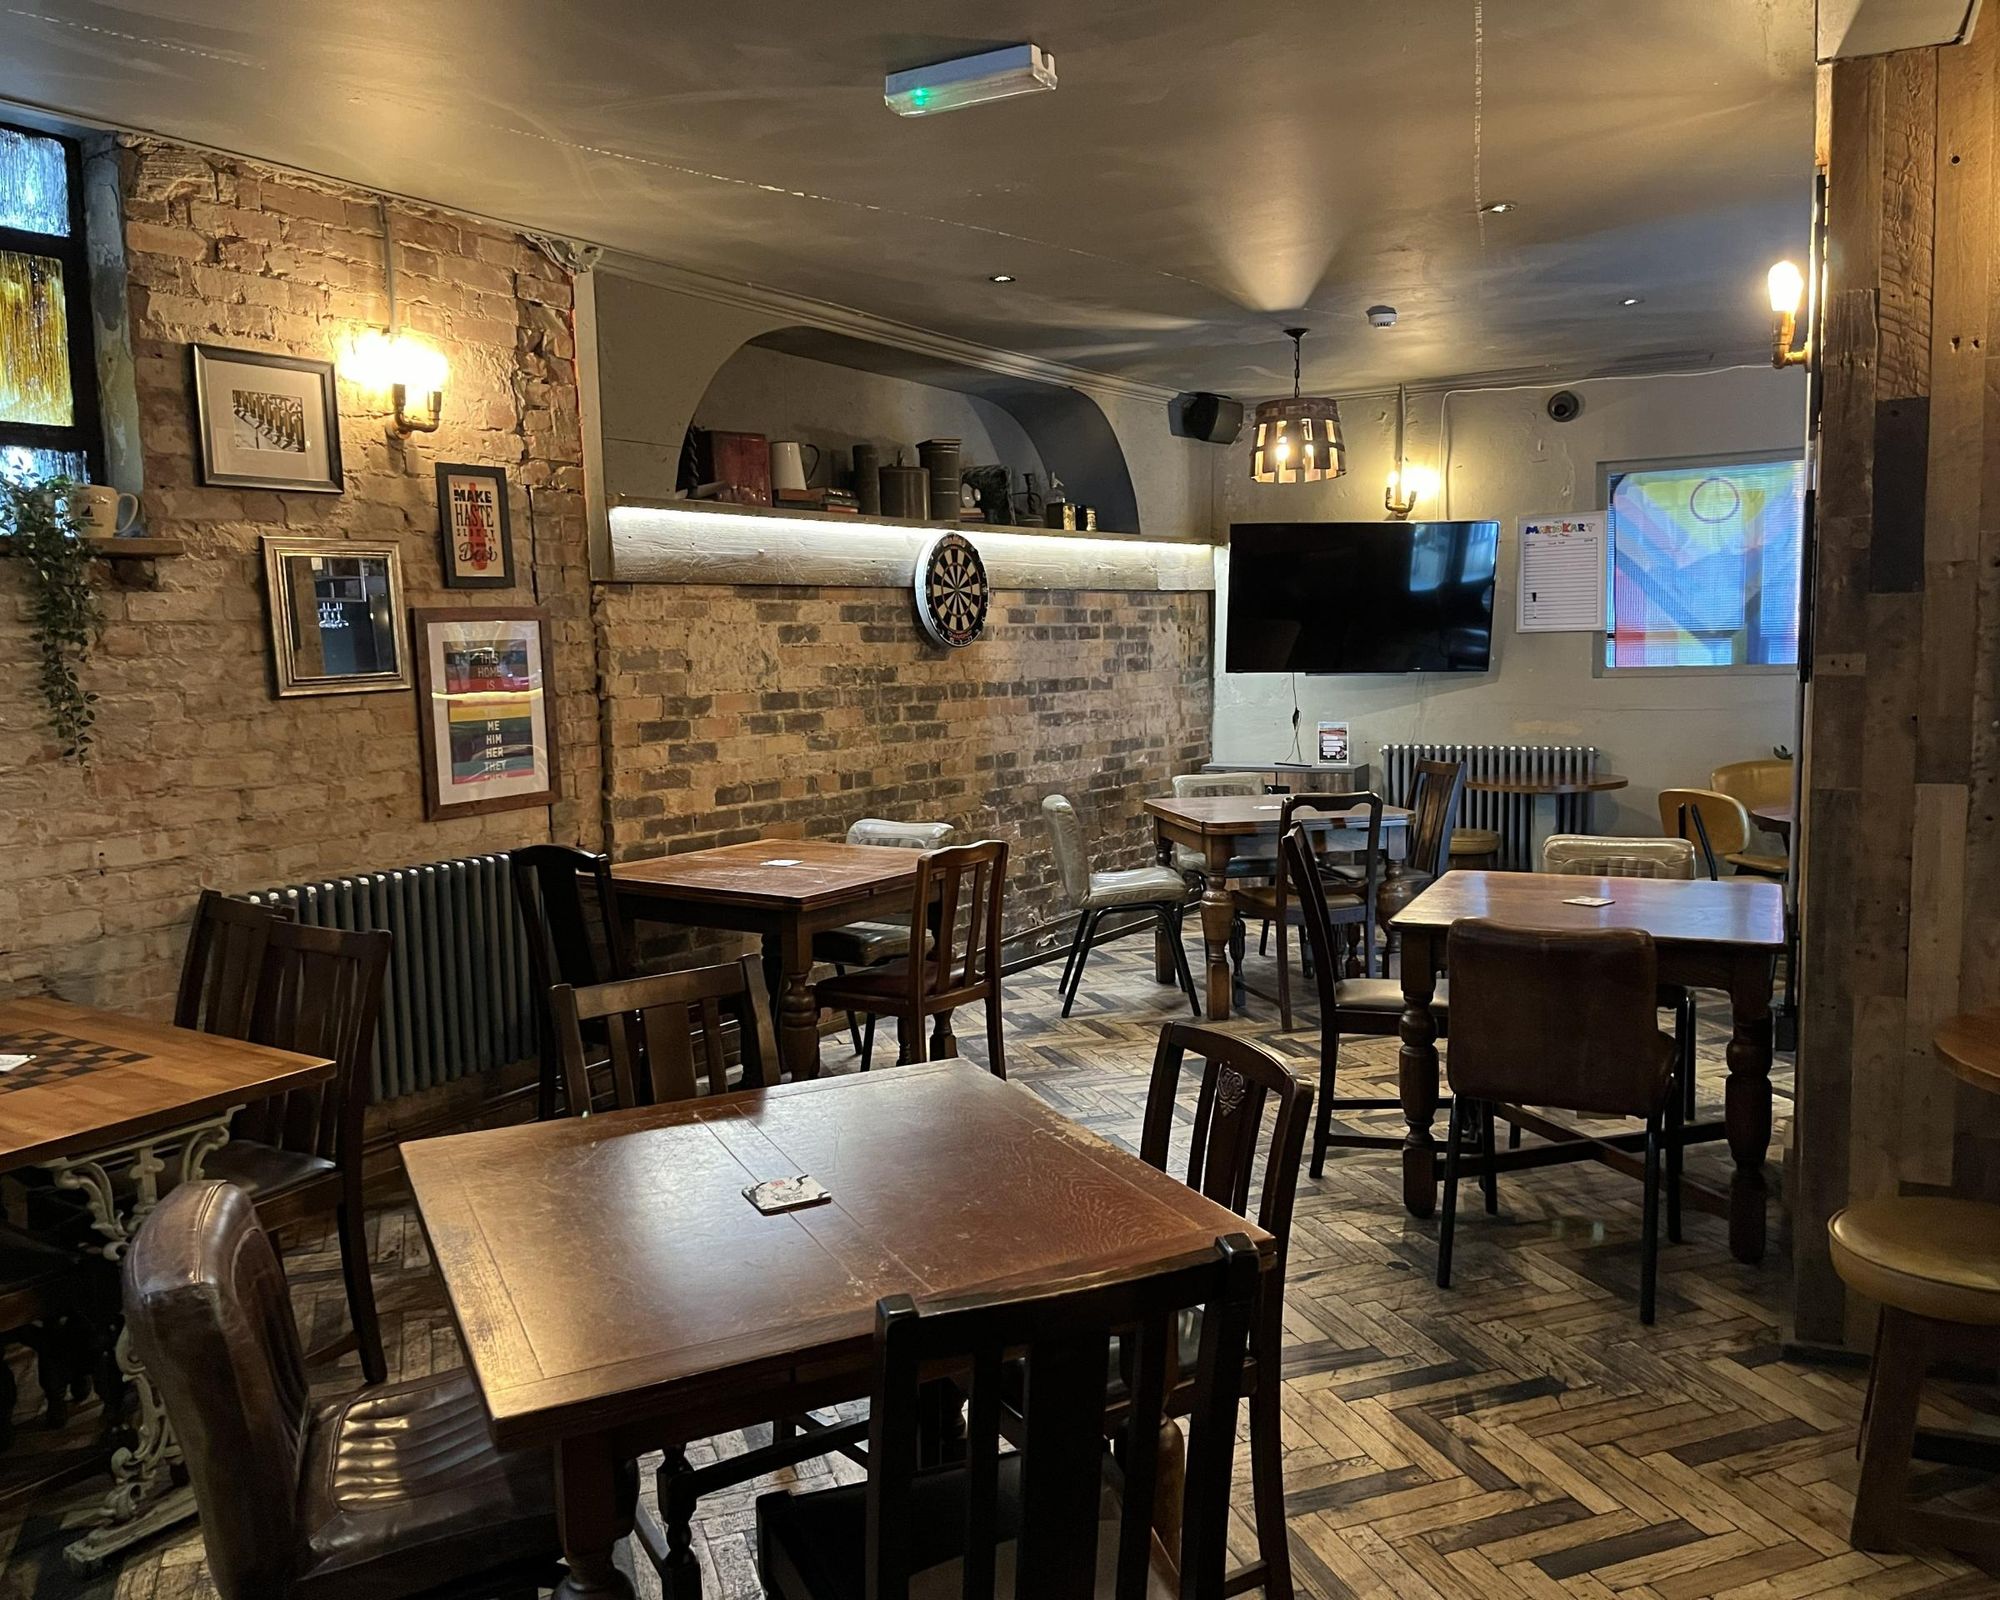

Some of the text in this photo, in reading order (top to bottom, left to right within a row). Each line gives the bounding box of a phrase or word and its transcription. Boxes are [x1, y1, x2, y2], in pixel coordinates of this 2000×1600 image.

[454, 489, 492, 503] MAKE
[455, 503, 494, 528] HASTE
[487, 680, 496, 690] IS
[487, 720, 500, 731] ME
[486, 733, 502, 745] HIM
[486, 747, 504, 758] HER
